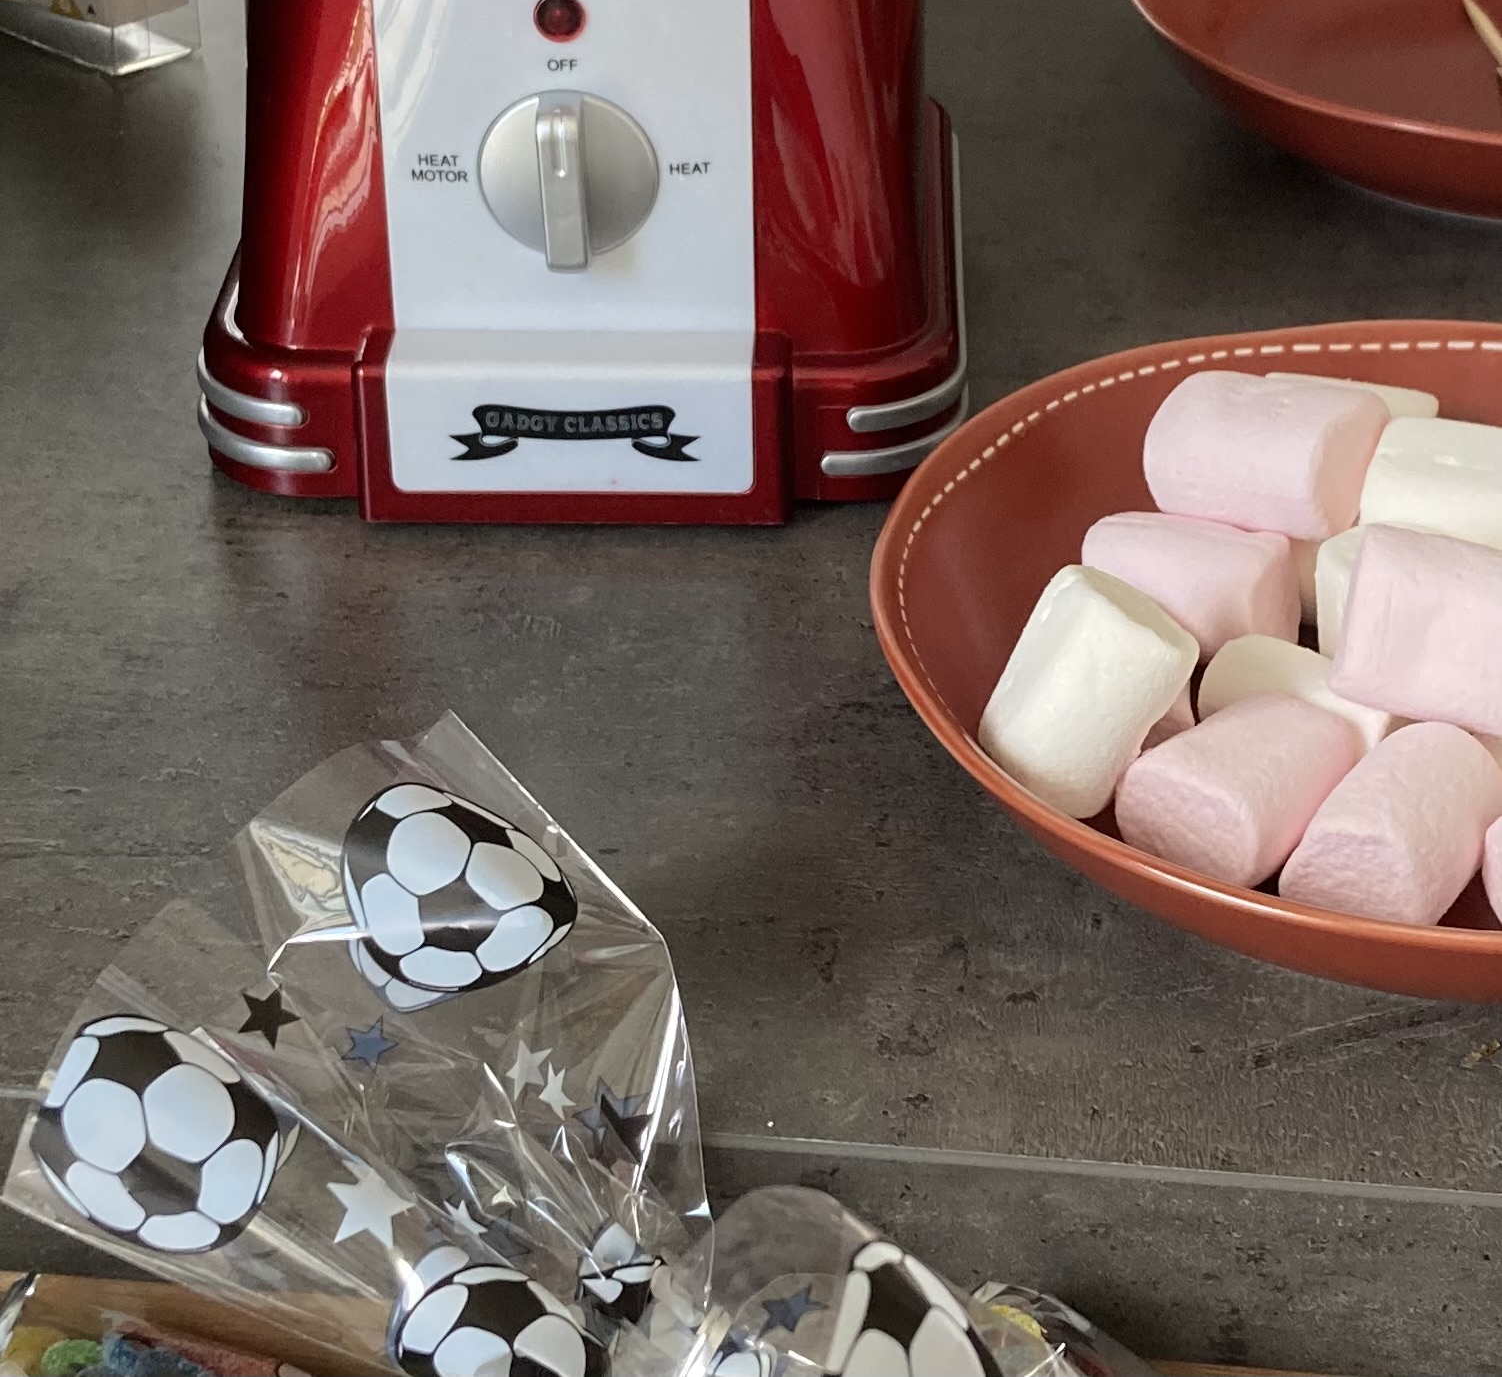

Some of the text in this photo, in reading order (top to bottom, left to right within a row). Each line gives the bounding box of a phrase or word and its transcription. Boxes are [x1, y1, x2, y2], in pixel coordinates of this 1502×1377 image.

[547, 58, 578, 72] OFF
[417, 153, 459, 167] HEAT
[411, 168, 469, 183] MOTOR
[669, 161, 711, 176] HEAT
[485, 411, 664, 433] GADGY CLASSICS
